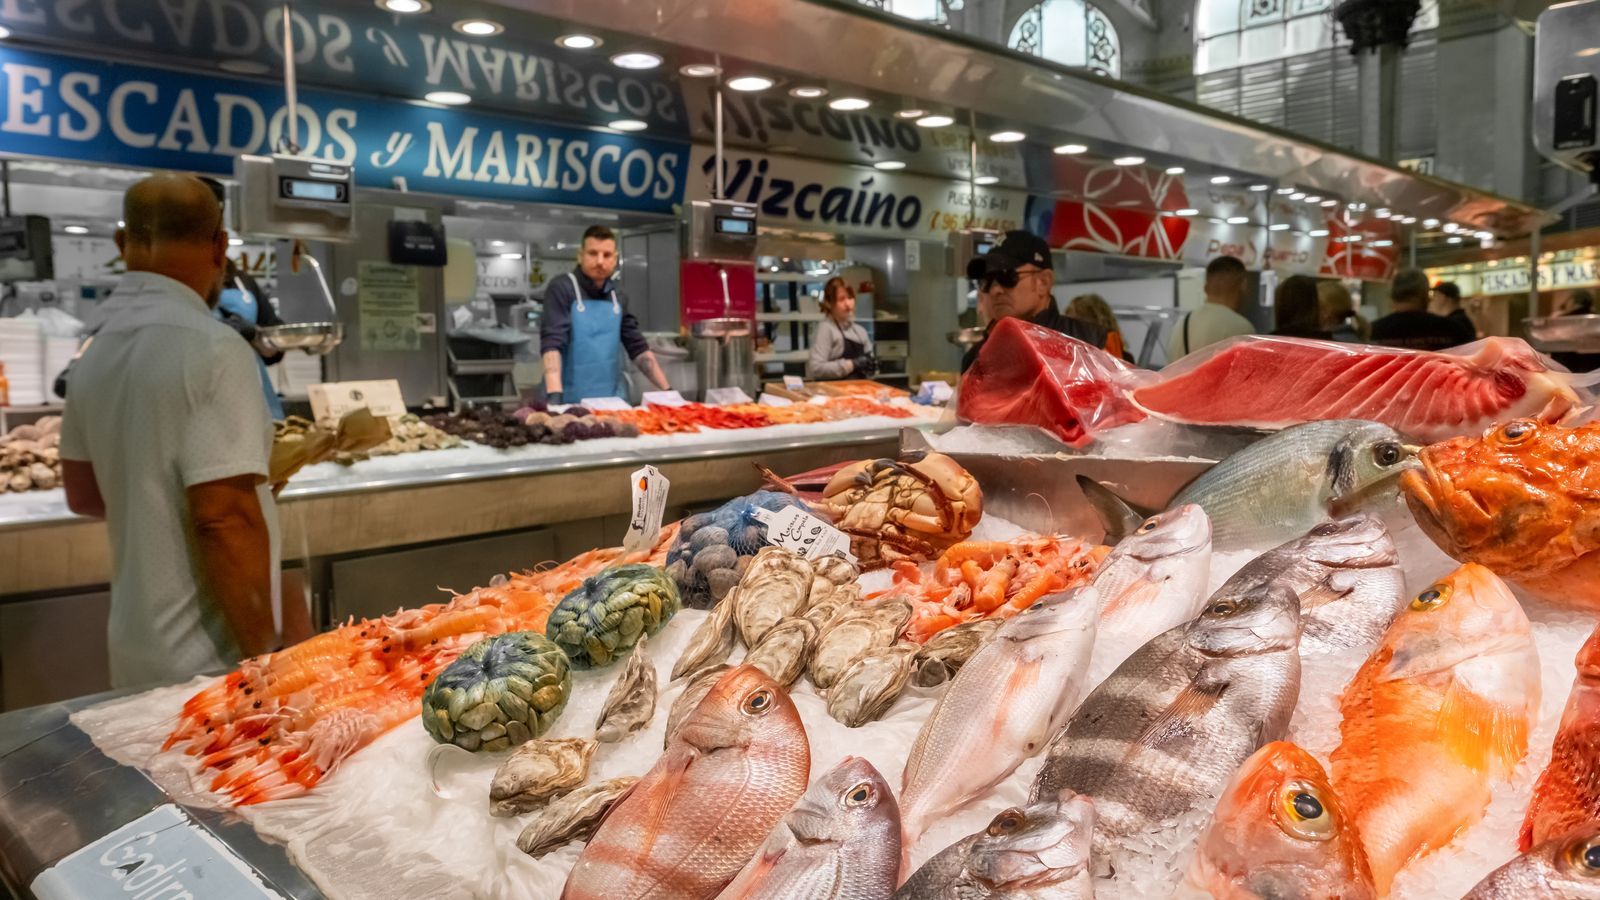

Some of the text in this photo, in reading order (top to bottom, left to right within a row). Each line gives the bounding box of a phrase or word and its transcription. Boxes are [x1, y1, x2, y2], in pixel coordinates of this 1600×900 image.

[2, 62, 678, 199] ESCADOS y MARISCOS
[702, 154, 922, 230] Vizcaíno
[947, 190, 987, 209] PUESOS
